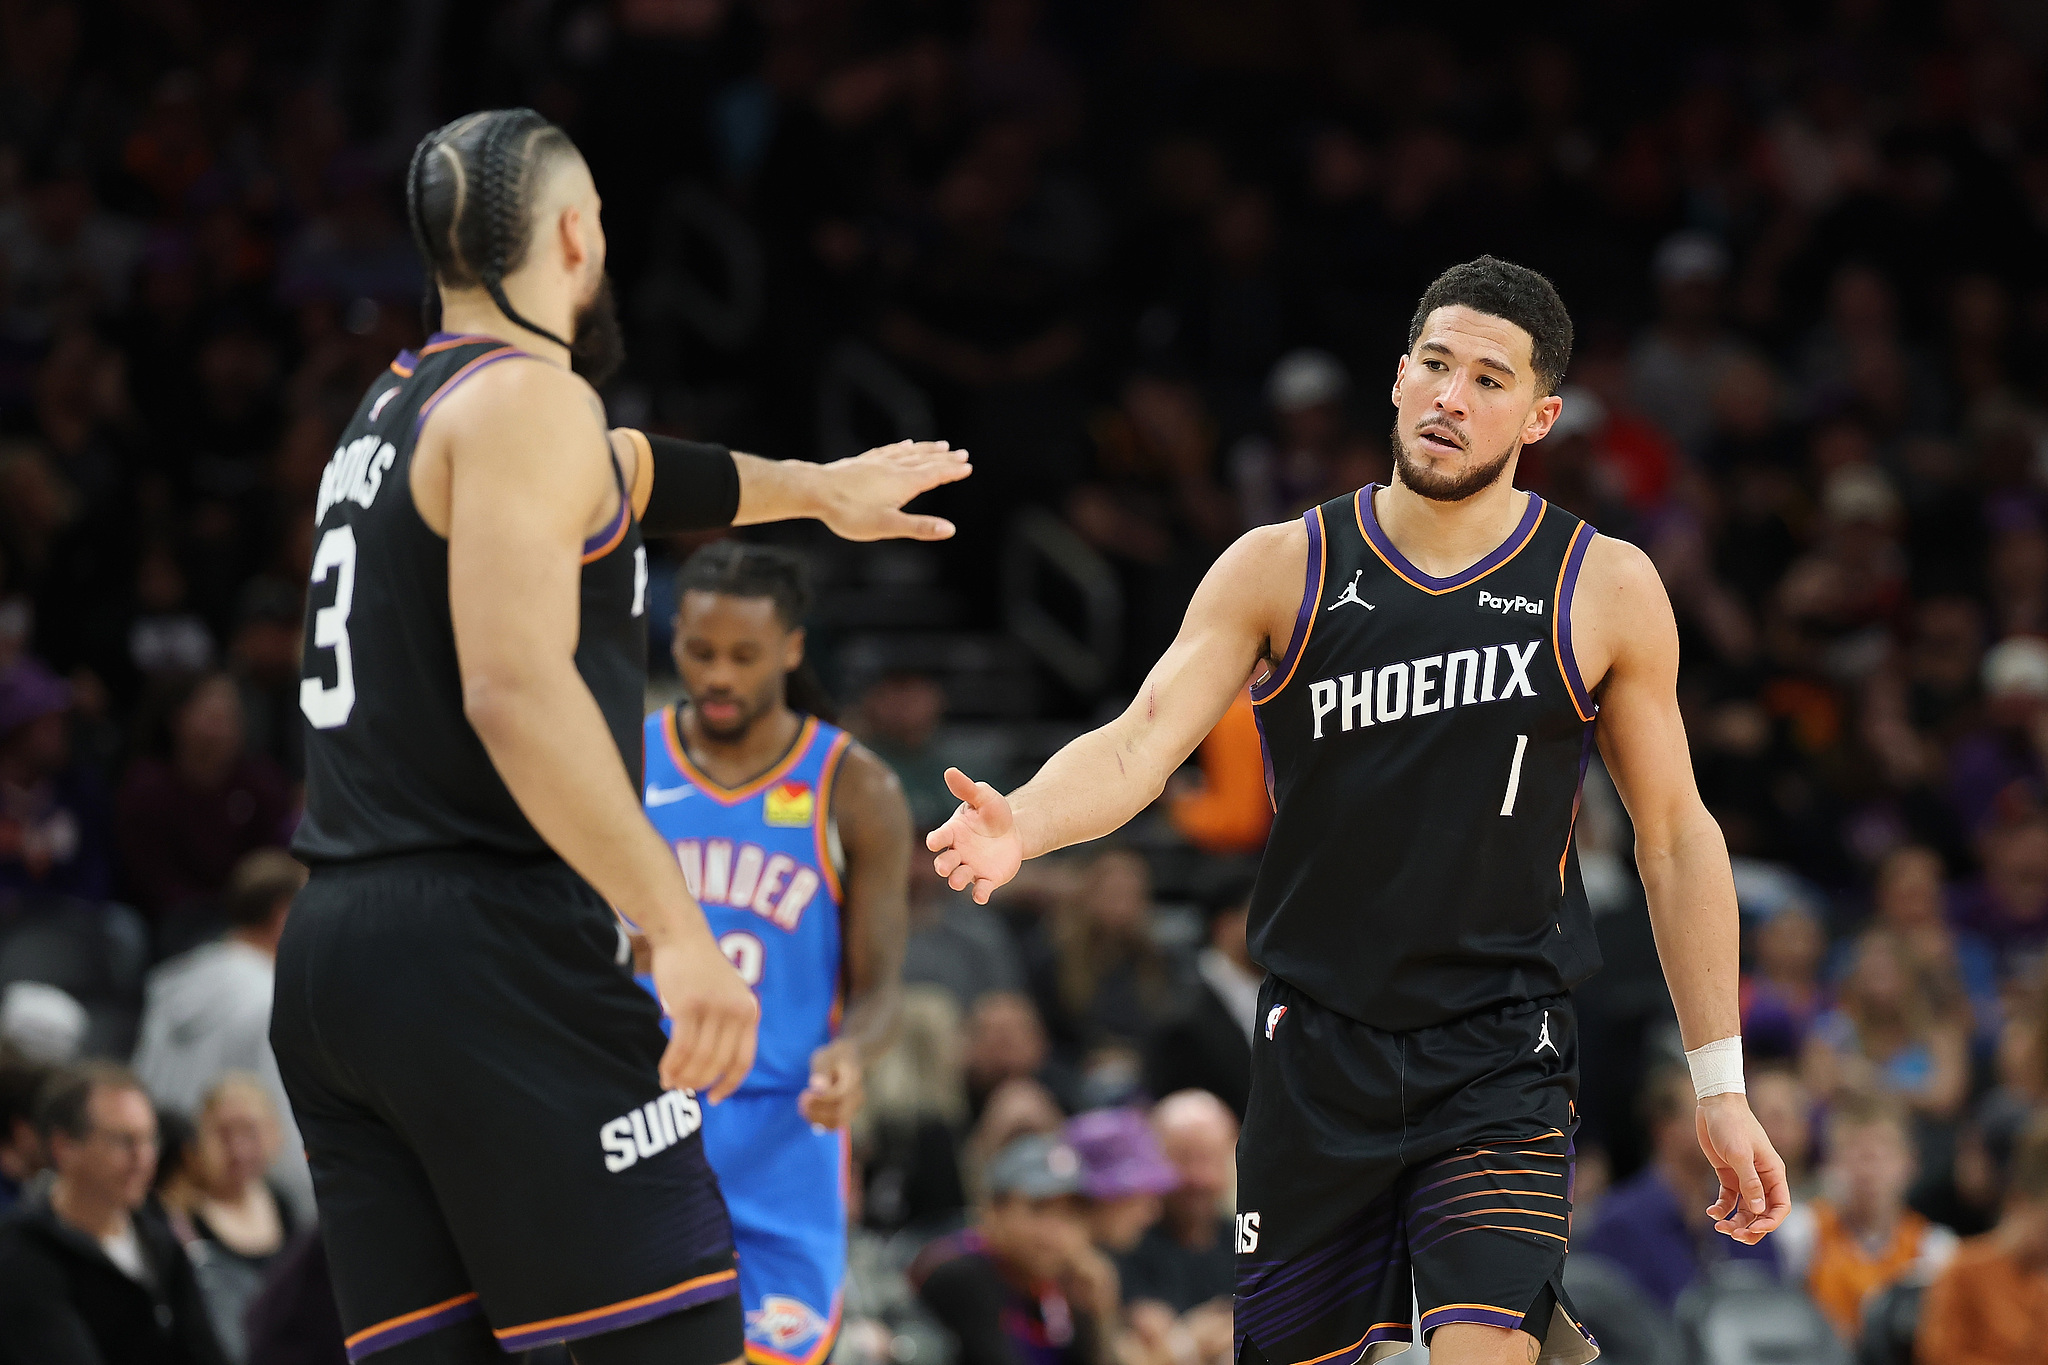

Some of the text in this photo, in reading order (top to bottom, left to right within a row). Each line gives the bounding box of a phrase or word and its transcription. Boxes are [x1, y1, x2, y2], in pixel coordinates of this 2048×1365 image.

[300, 524, 356, 730] 3
[1478, 590, 1544, 615] PayPal
[1308, 640, 1542, 740] PHOENIX
[1500, 734, 1528, 817] 1
[674, 838, 821, 932] UNDER
[600, 1088, 702, 1174] SUNS
